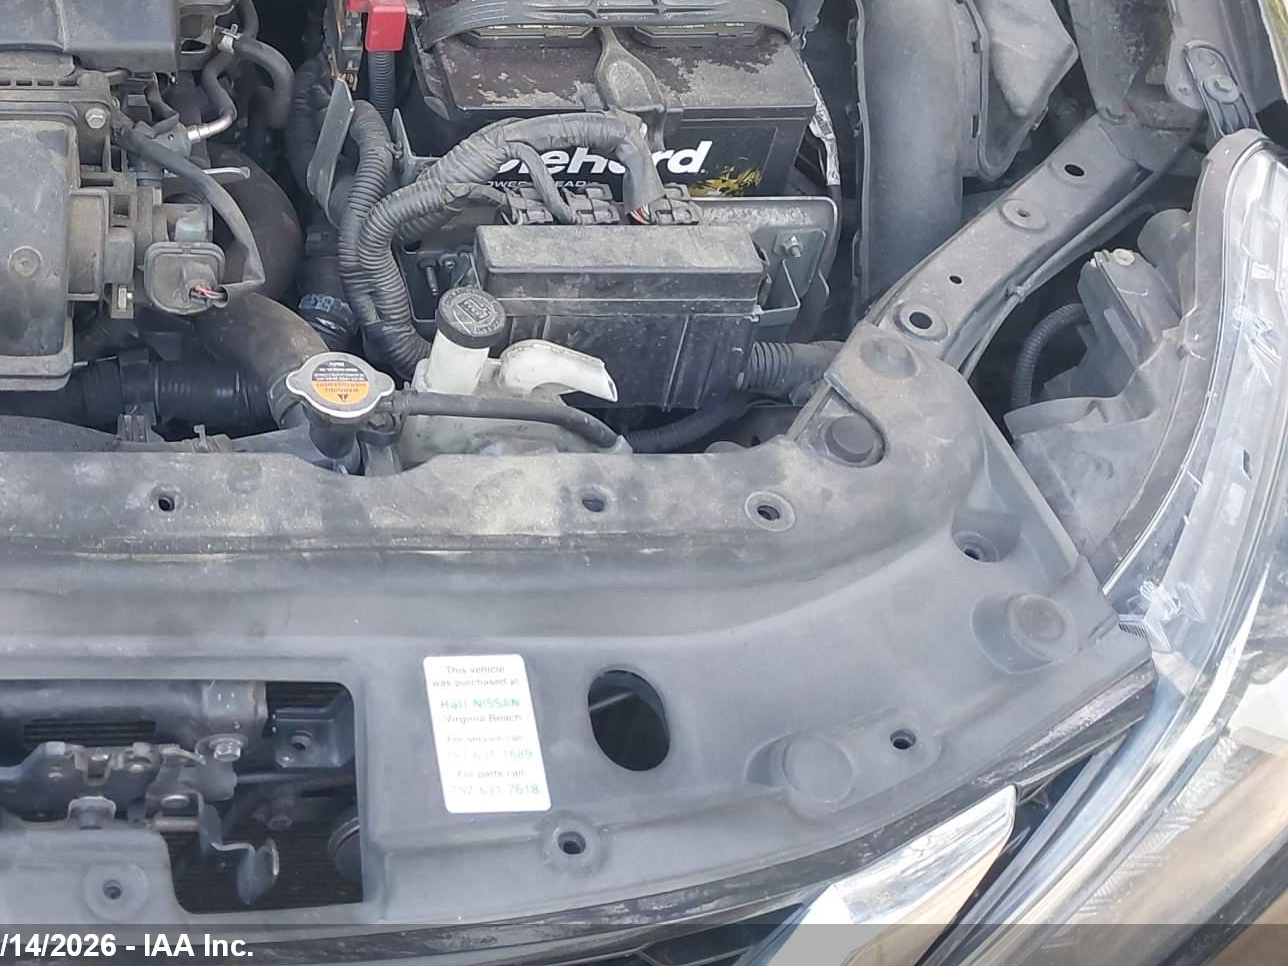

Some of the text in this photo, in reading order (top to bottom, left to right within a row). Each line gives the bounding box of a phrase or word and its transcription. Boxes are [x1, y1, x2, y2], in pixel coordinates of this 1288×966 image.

[446, 665, 505, 674] This vehicle
[455, 678, 507, 689] purchased
[440, 698, 520, 709] Hall NISSAN
[445, 714, 522, 724] Virginia Beach
[477, 769, 504, 779] parts
